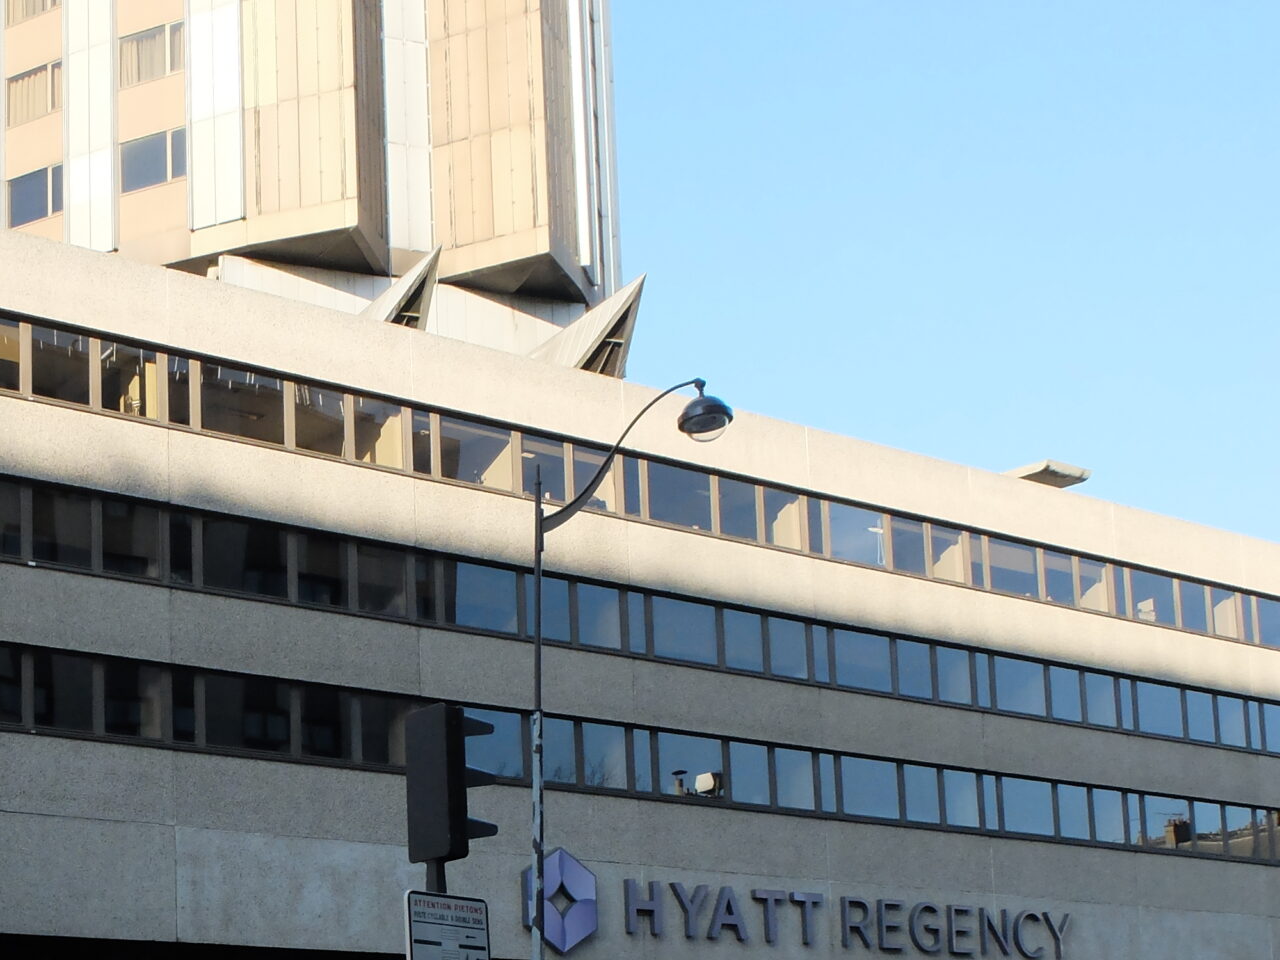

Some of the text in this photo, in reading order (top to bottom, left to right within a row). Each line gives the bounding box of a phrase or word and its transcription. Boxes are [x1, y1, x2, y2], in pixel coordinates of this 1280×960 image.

[414, 899, 483, 916] ATTENTION PIETONS
[623, 877, 1072, 960] HYATT REGENCY
